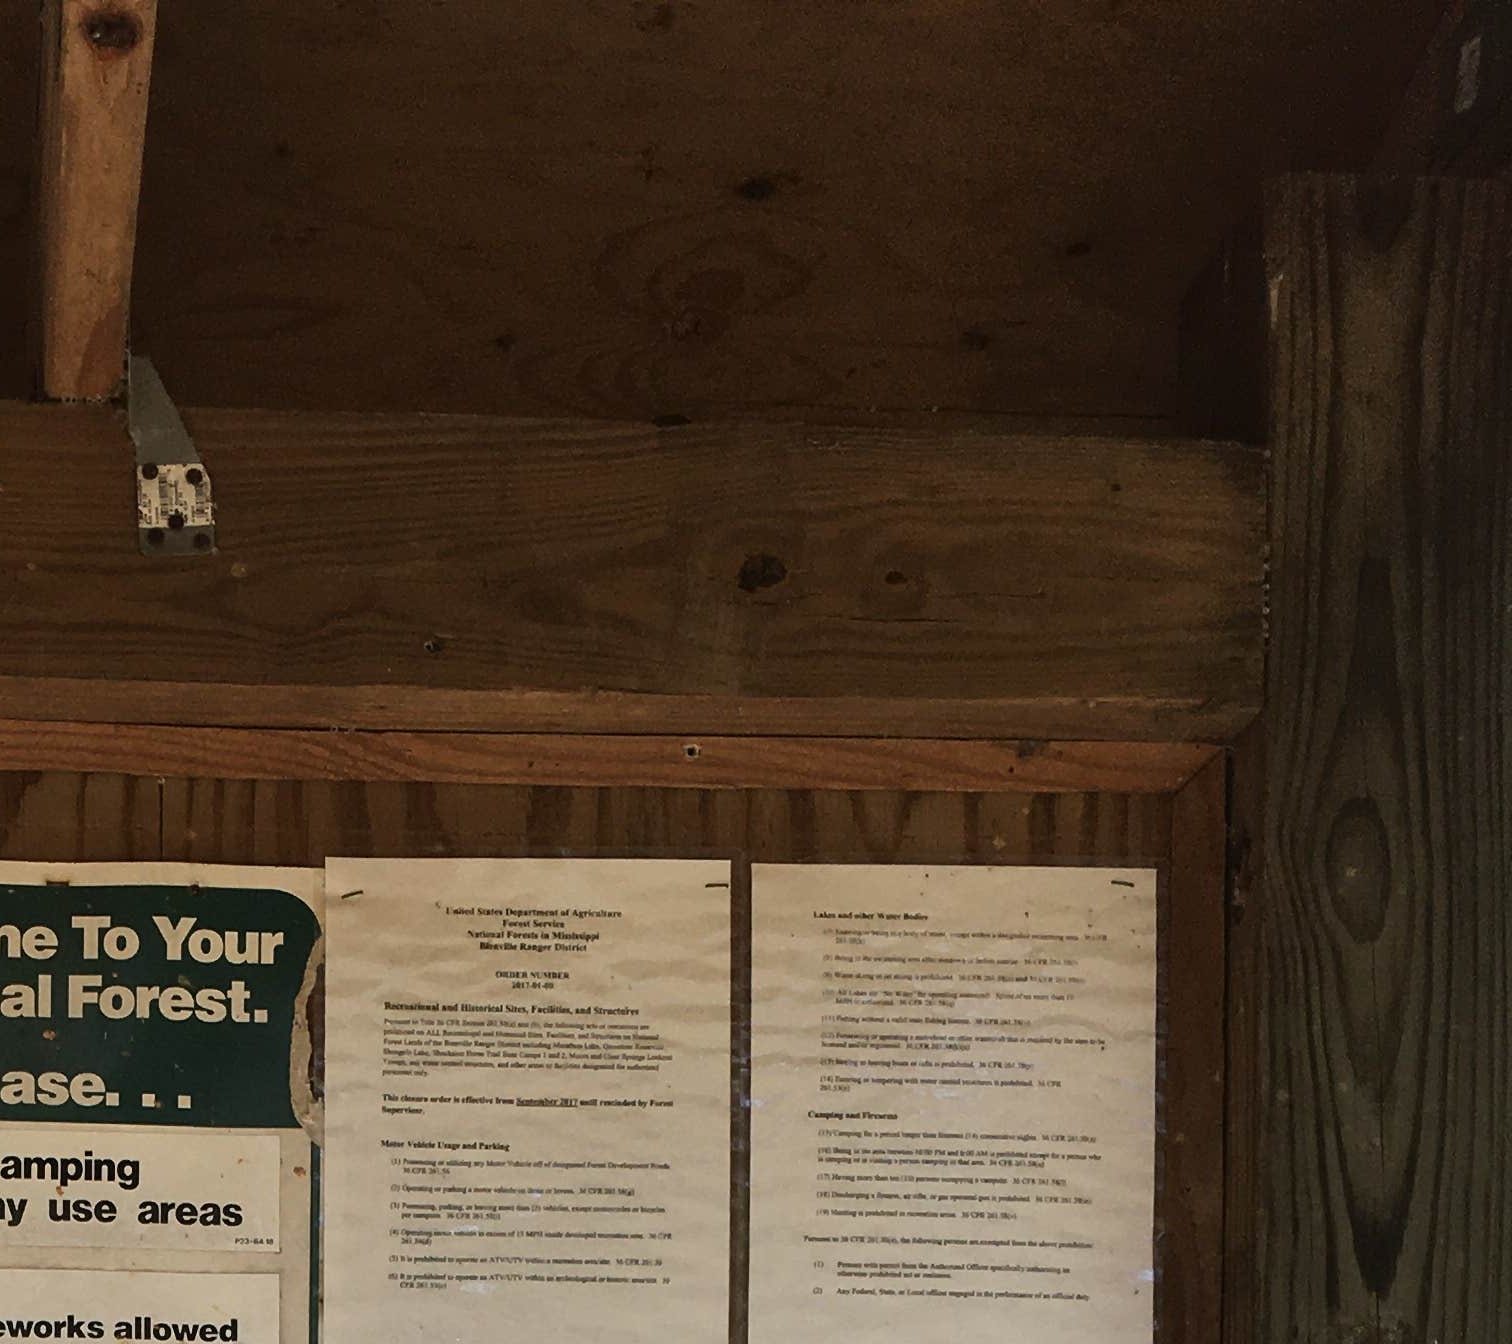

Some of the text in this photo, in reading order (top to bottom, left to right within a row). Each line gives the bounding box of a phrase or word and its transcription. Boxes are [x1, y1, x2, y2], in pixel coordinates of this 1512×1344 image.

[505, 909, 558, 918] Department
[572, 909, 622, 919] Agriculture
[72, 915, 140, 960] To
[153, 916, 284, 965] Your
[67, 974, 269, 1024] Forest.
[48, 1198, 116, 1223] use
[138, 1201, 243, 1226] areas
[114, 1317, 238, 1342] allowed
